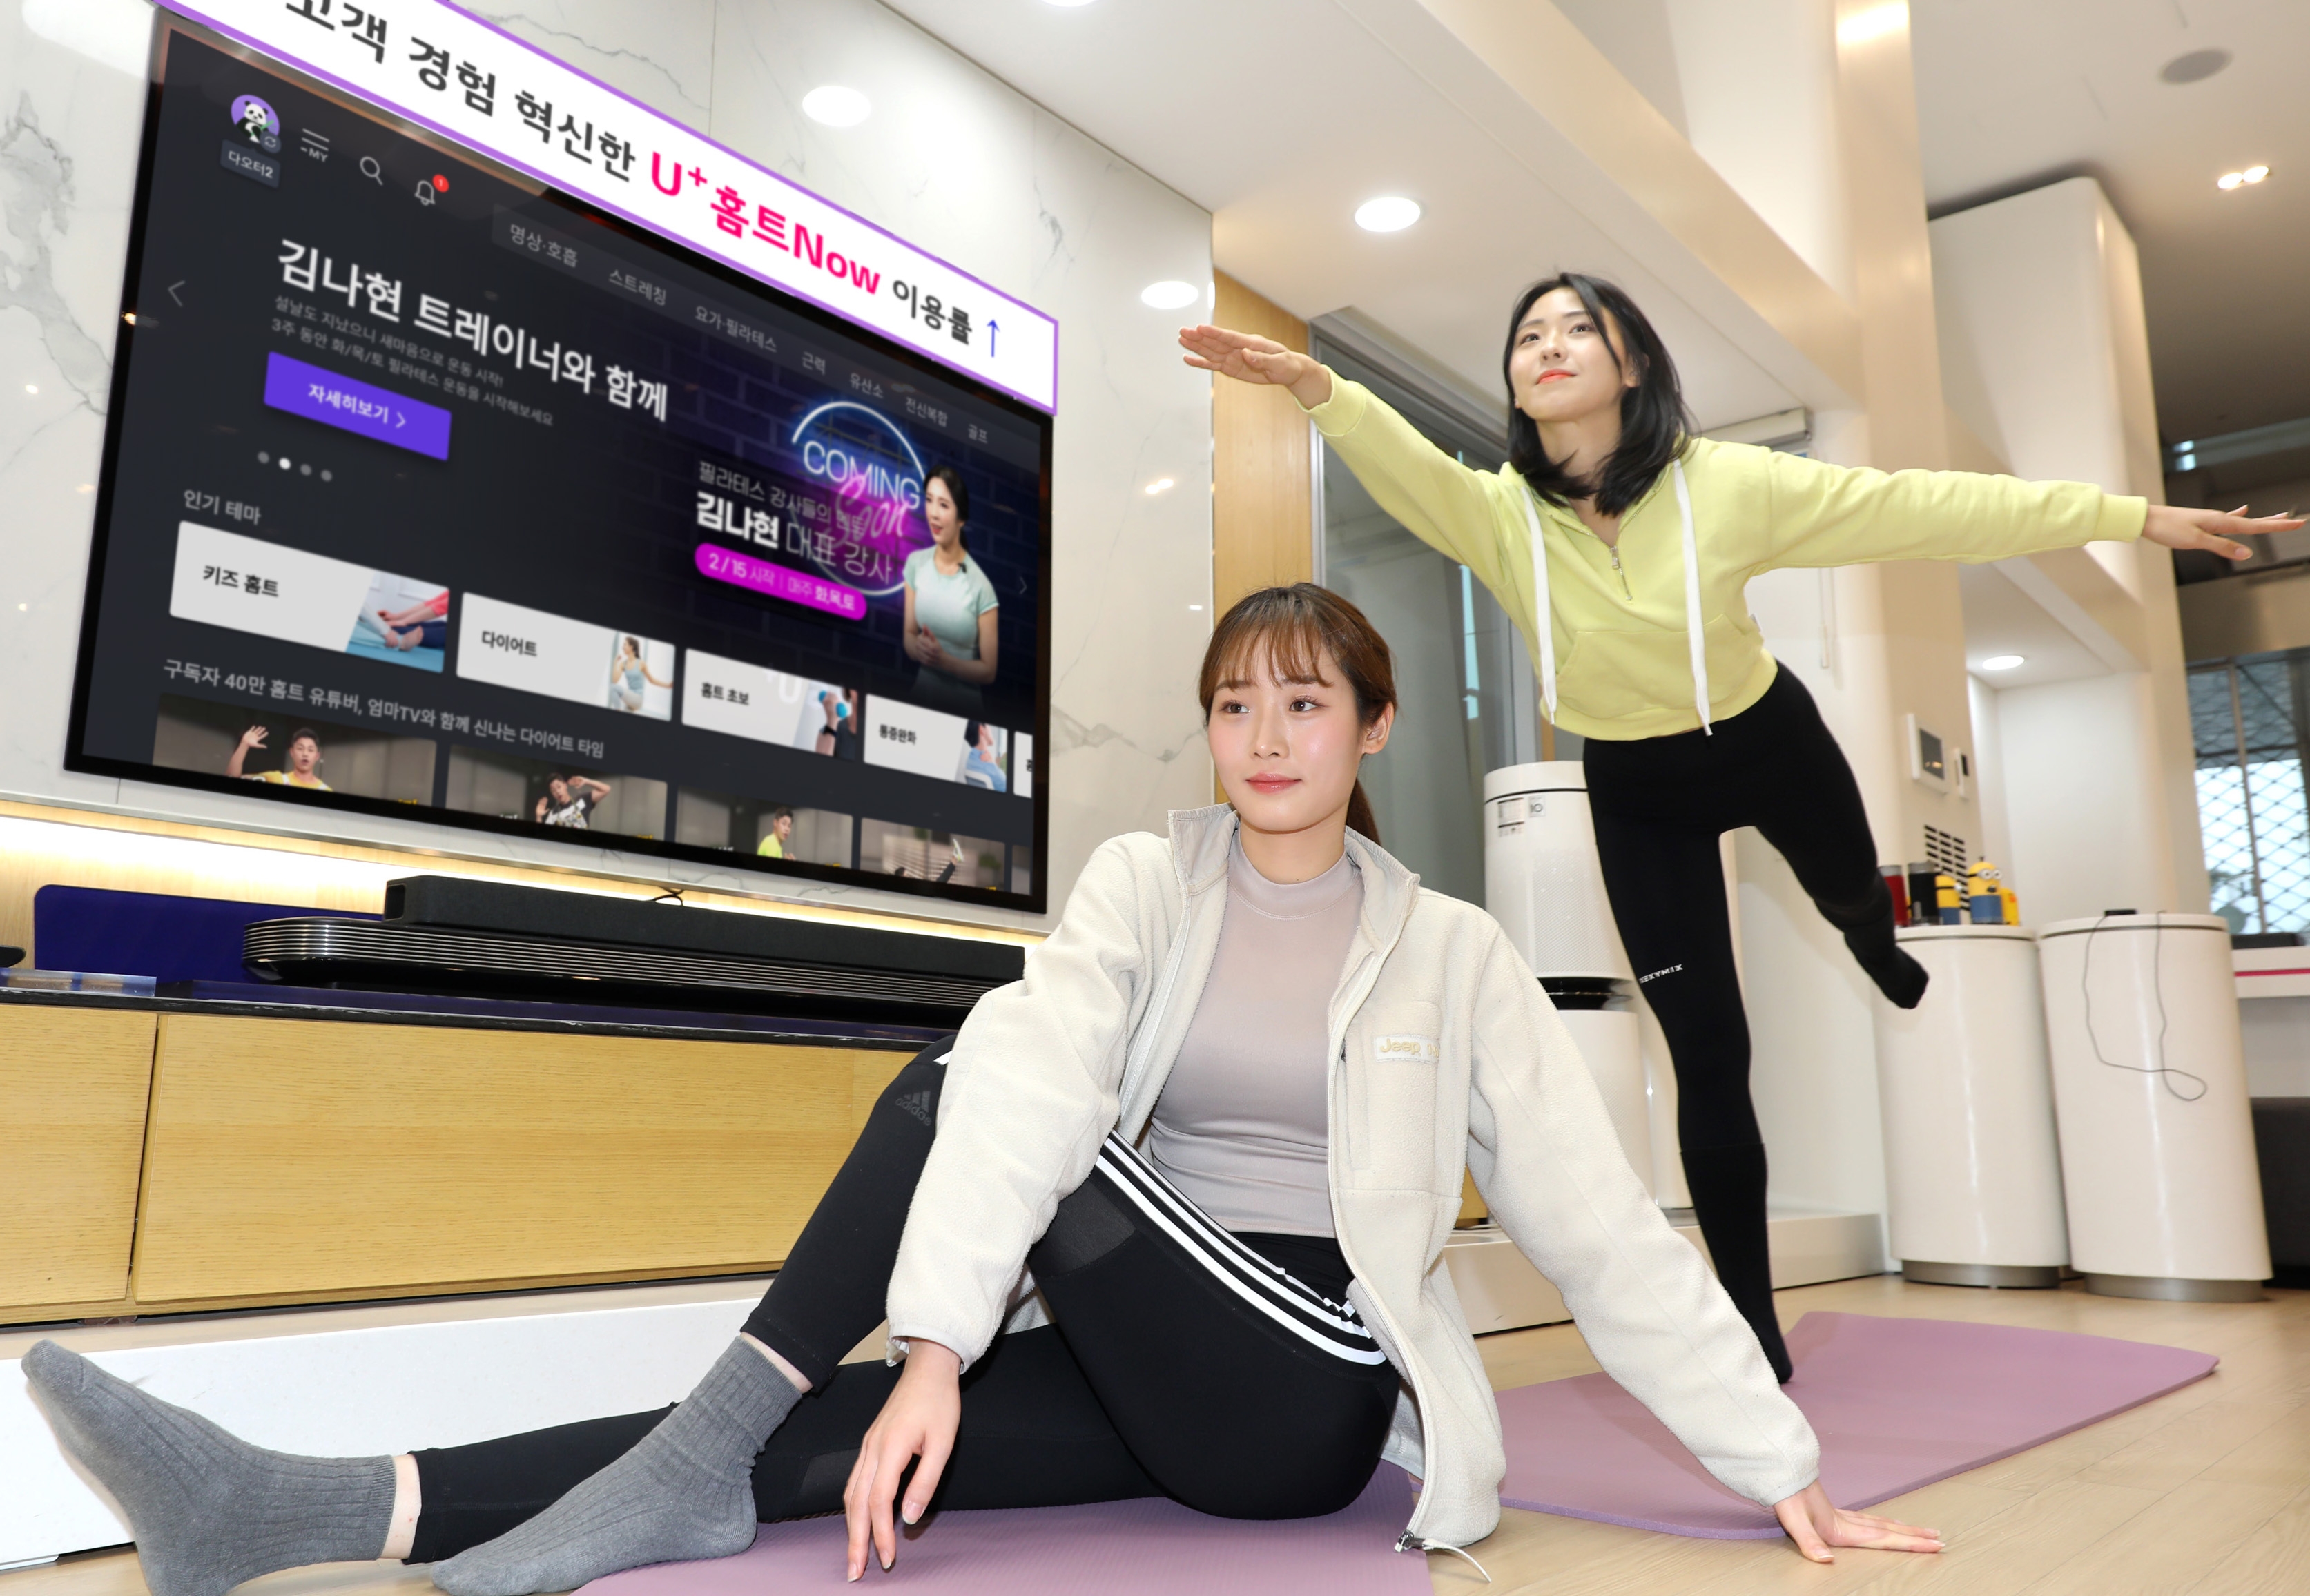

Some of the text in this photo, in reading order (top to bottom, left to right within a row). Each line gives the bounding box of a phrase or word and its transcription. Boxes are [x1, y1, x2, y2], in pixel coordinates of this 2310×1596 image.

[228, 150, 274, 178] 다오터2
[308, 148, 328, 162] MY
[275, 295, 317, 321] 설날도
[321, 312, 376, 343] 지났으니
[448, 358, 472, 377] 운동
[278, 238, 668, 423] 김나현 트레이너와 함께
[272, 318, 295, 336] 3주
[300, 327, 329, 349] 동안
[389, 358, 439, 387] 필라테스
[443, 377, 480, 402] 운동을
[608, 269, 668, 306] 스트레칭
[802, 351, 826, 375] 근력
[850, 372, 884, 399] 유산소
[905, 397, 949, 427] 전신복합
[967, 423, 989, 444] 골프
[309, 383, 389, 425] 자세히보기
[699, 461, 765, 502] 필라테스
[770, 486, 831, 523] 강사들의
[804, 440, 920, 511] COMING
[184, 490, 262, 525] 인기 테마
[697, 491, 893, 585] 김나현 대표 강사
[203, 565, 280, 598] 키즈 홈트
[749, 566, 775, 586] 시작
[481, 630, 538, 659] 다이어트
[163, 659, 604, 758] 구독자 40만 홈트 유튜버, 엄마TV와 함께 신나는 다이어트 타임
[701, 683, 750, 707] 홈트 초보
[879, 724, 917, 746] 통증완화
[1380, 1038, 1421, 1055] Jeep
[895, 1098, 932, 1127] adidas
